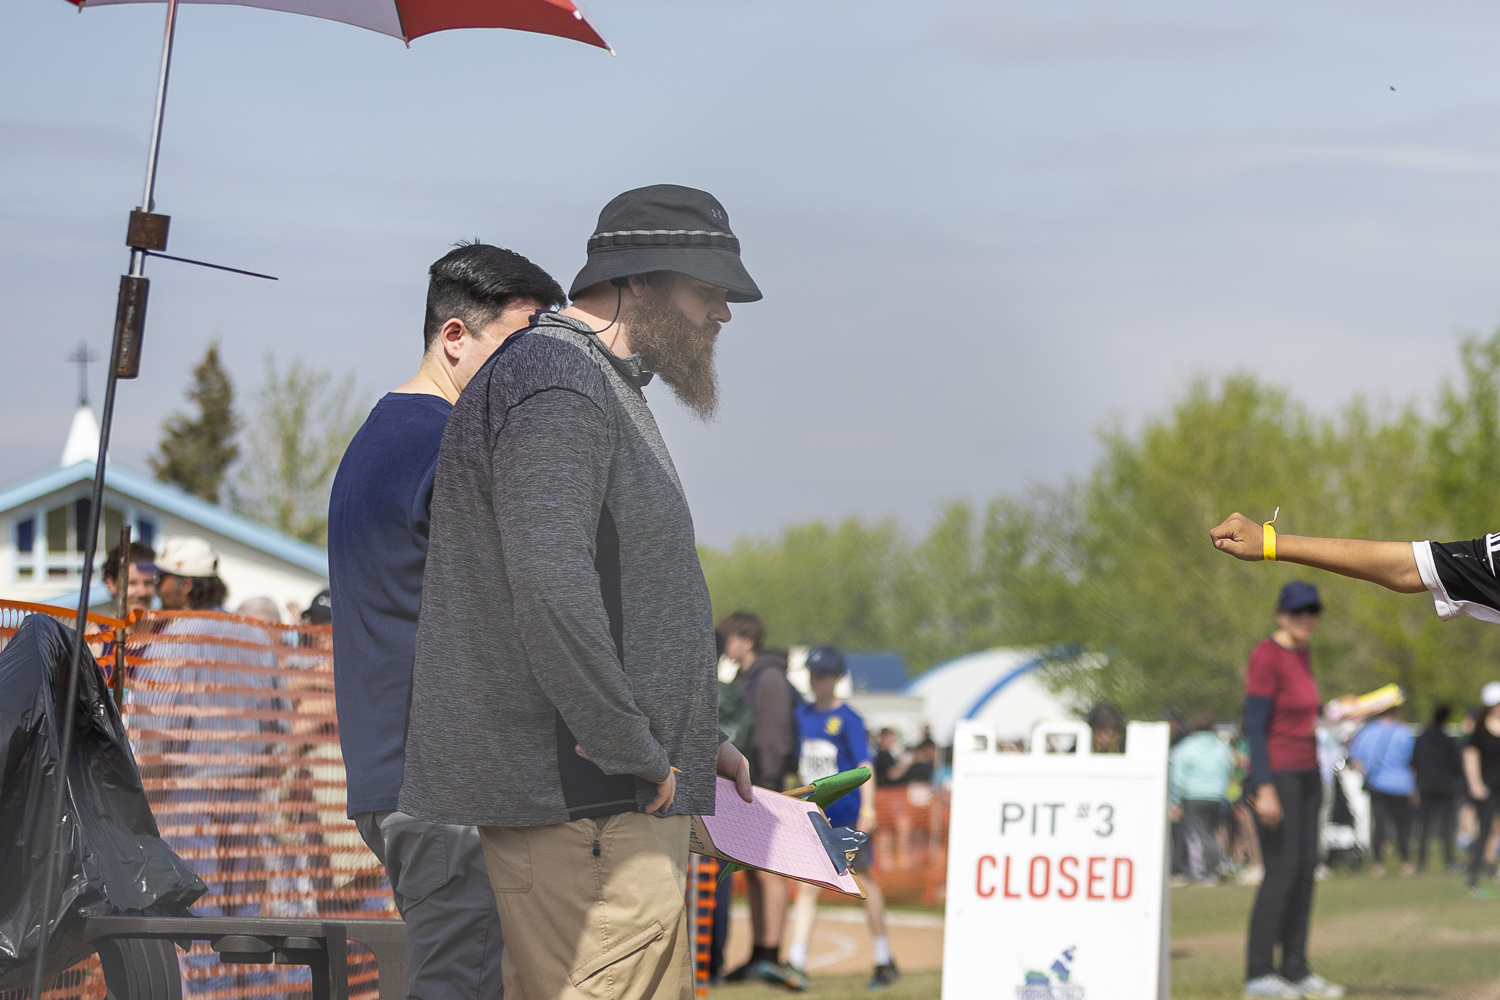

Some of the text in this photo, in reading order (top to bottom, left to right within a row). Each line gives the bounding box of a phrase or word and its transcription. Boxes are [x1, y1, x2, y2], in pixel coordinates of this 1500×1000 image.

[1000, 802, 1115, 837] PIT #3
[975, 855, 1134, 901] CLOSED
